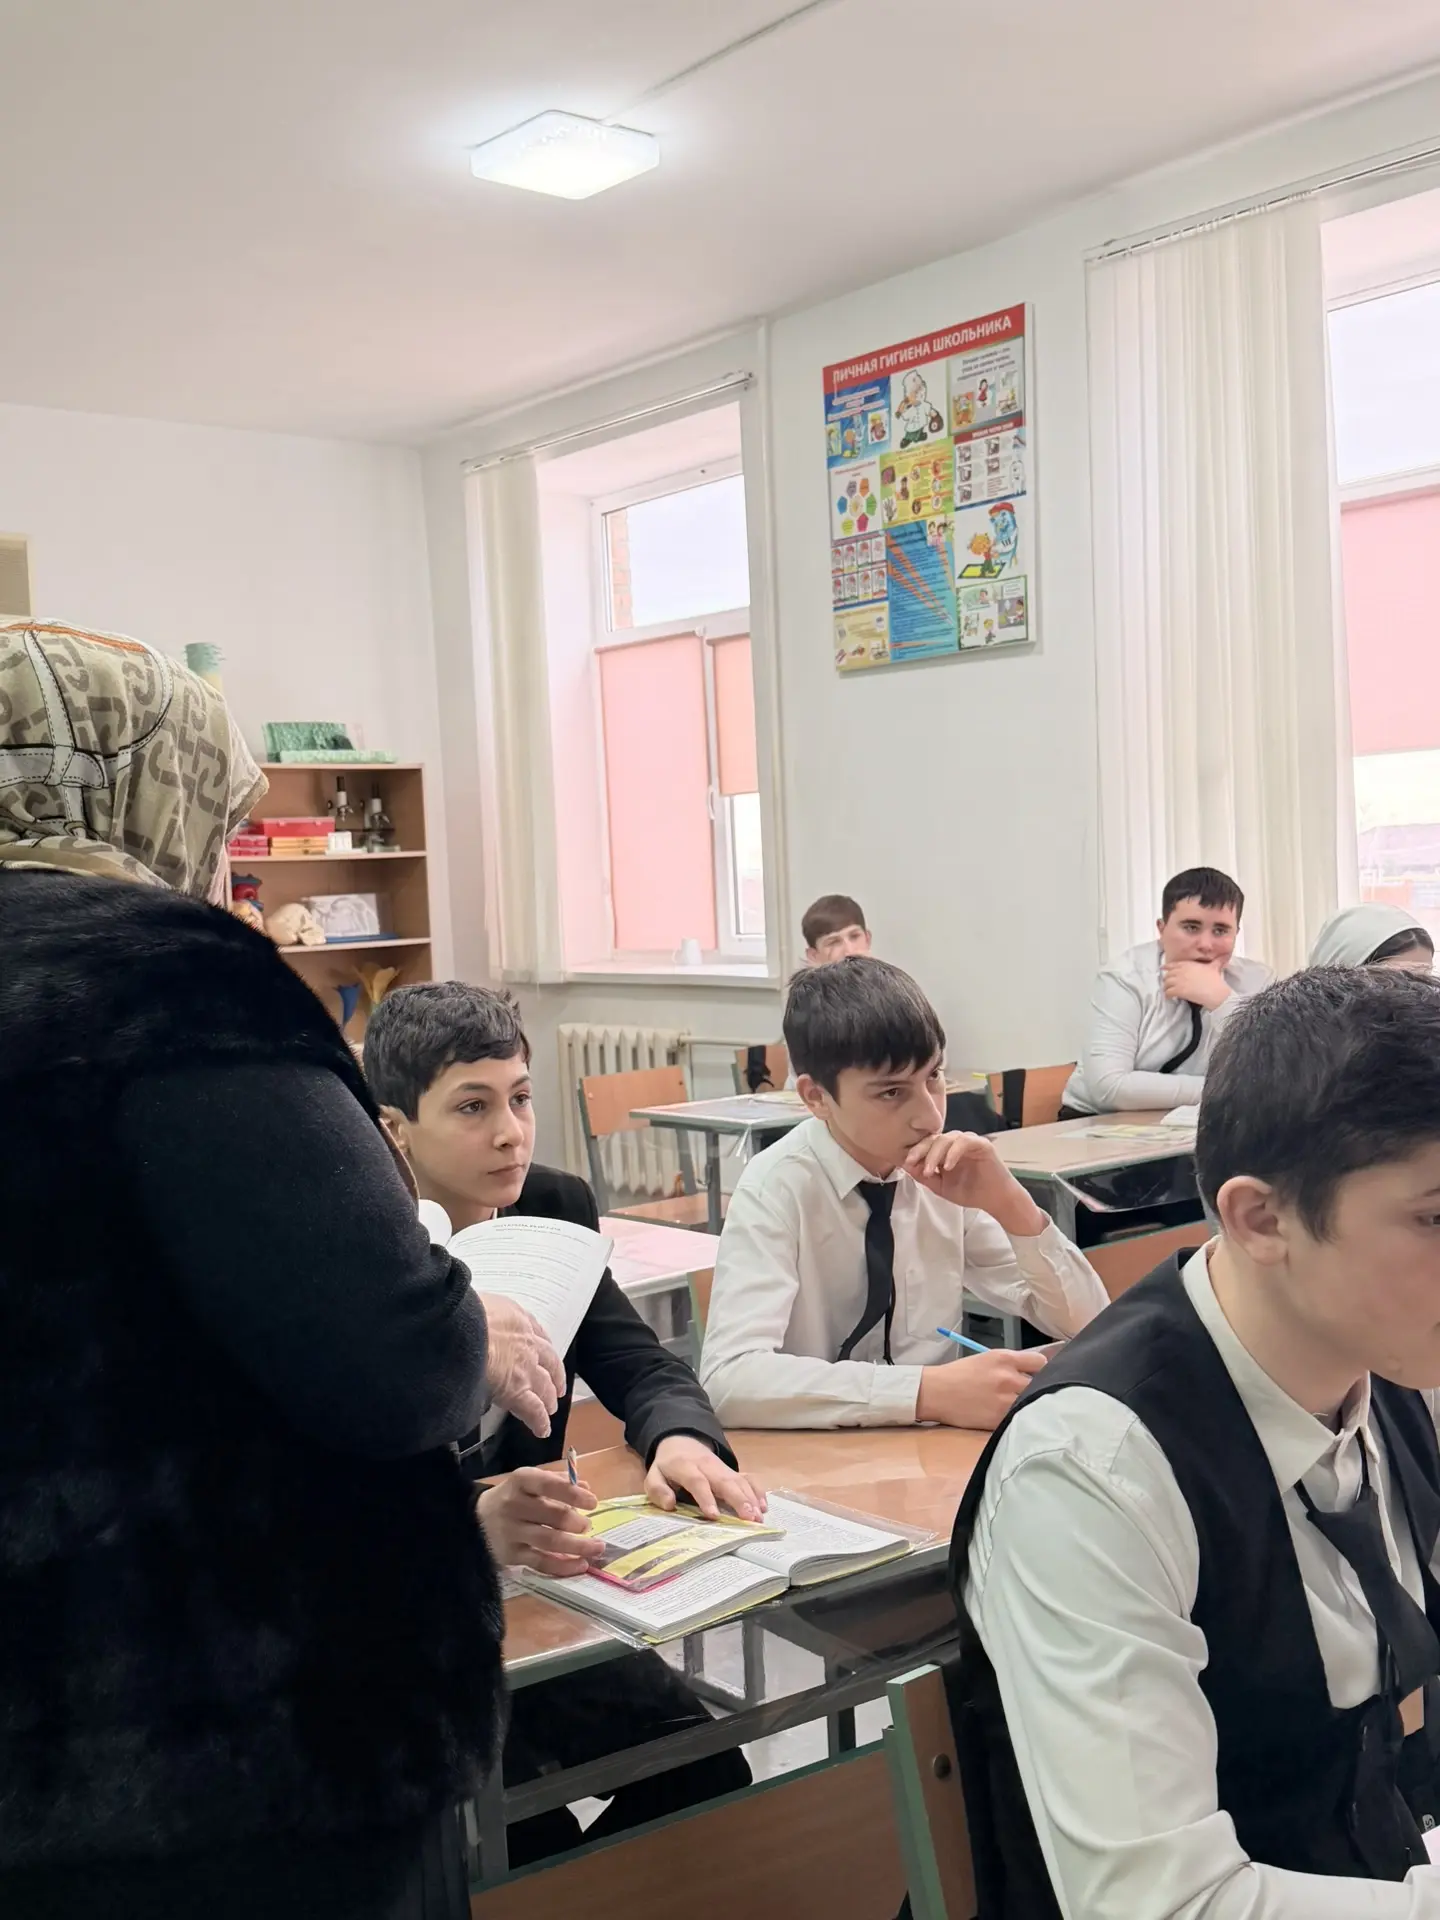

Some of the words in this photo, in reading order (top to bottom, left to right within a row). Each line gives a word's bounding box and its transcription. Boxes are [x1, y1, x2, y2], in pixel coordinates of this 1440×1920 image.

[832, 357, 878, 384] ЛИЧНАЯ
[879, 341, 931, 369] ГИГИЕНА
[932, 315, 1012, 351] ШКОЛЬНИКА
